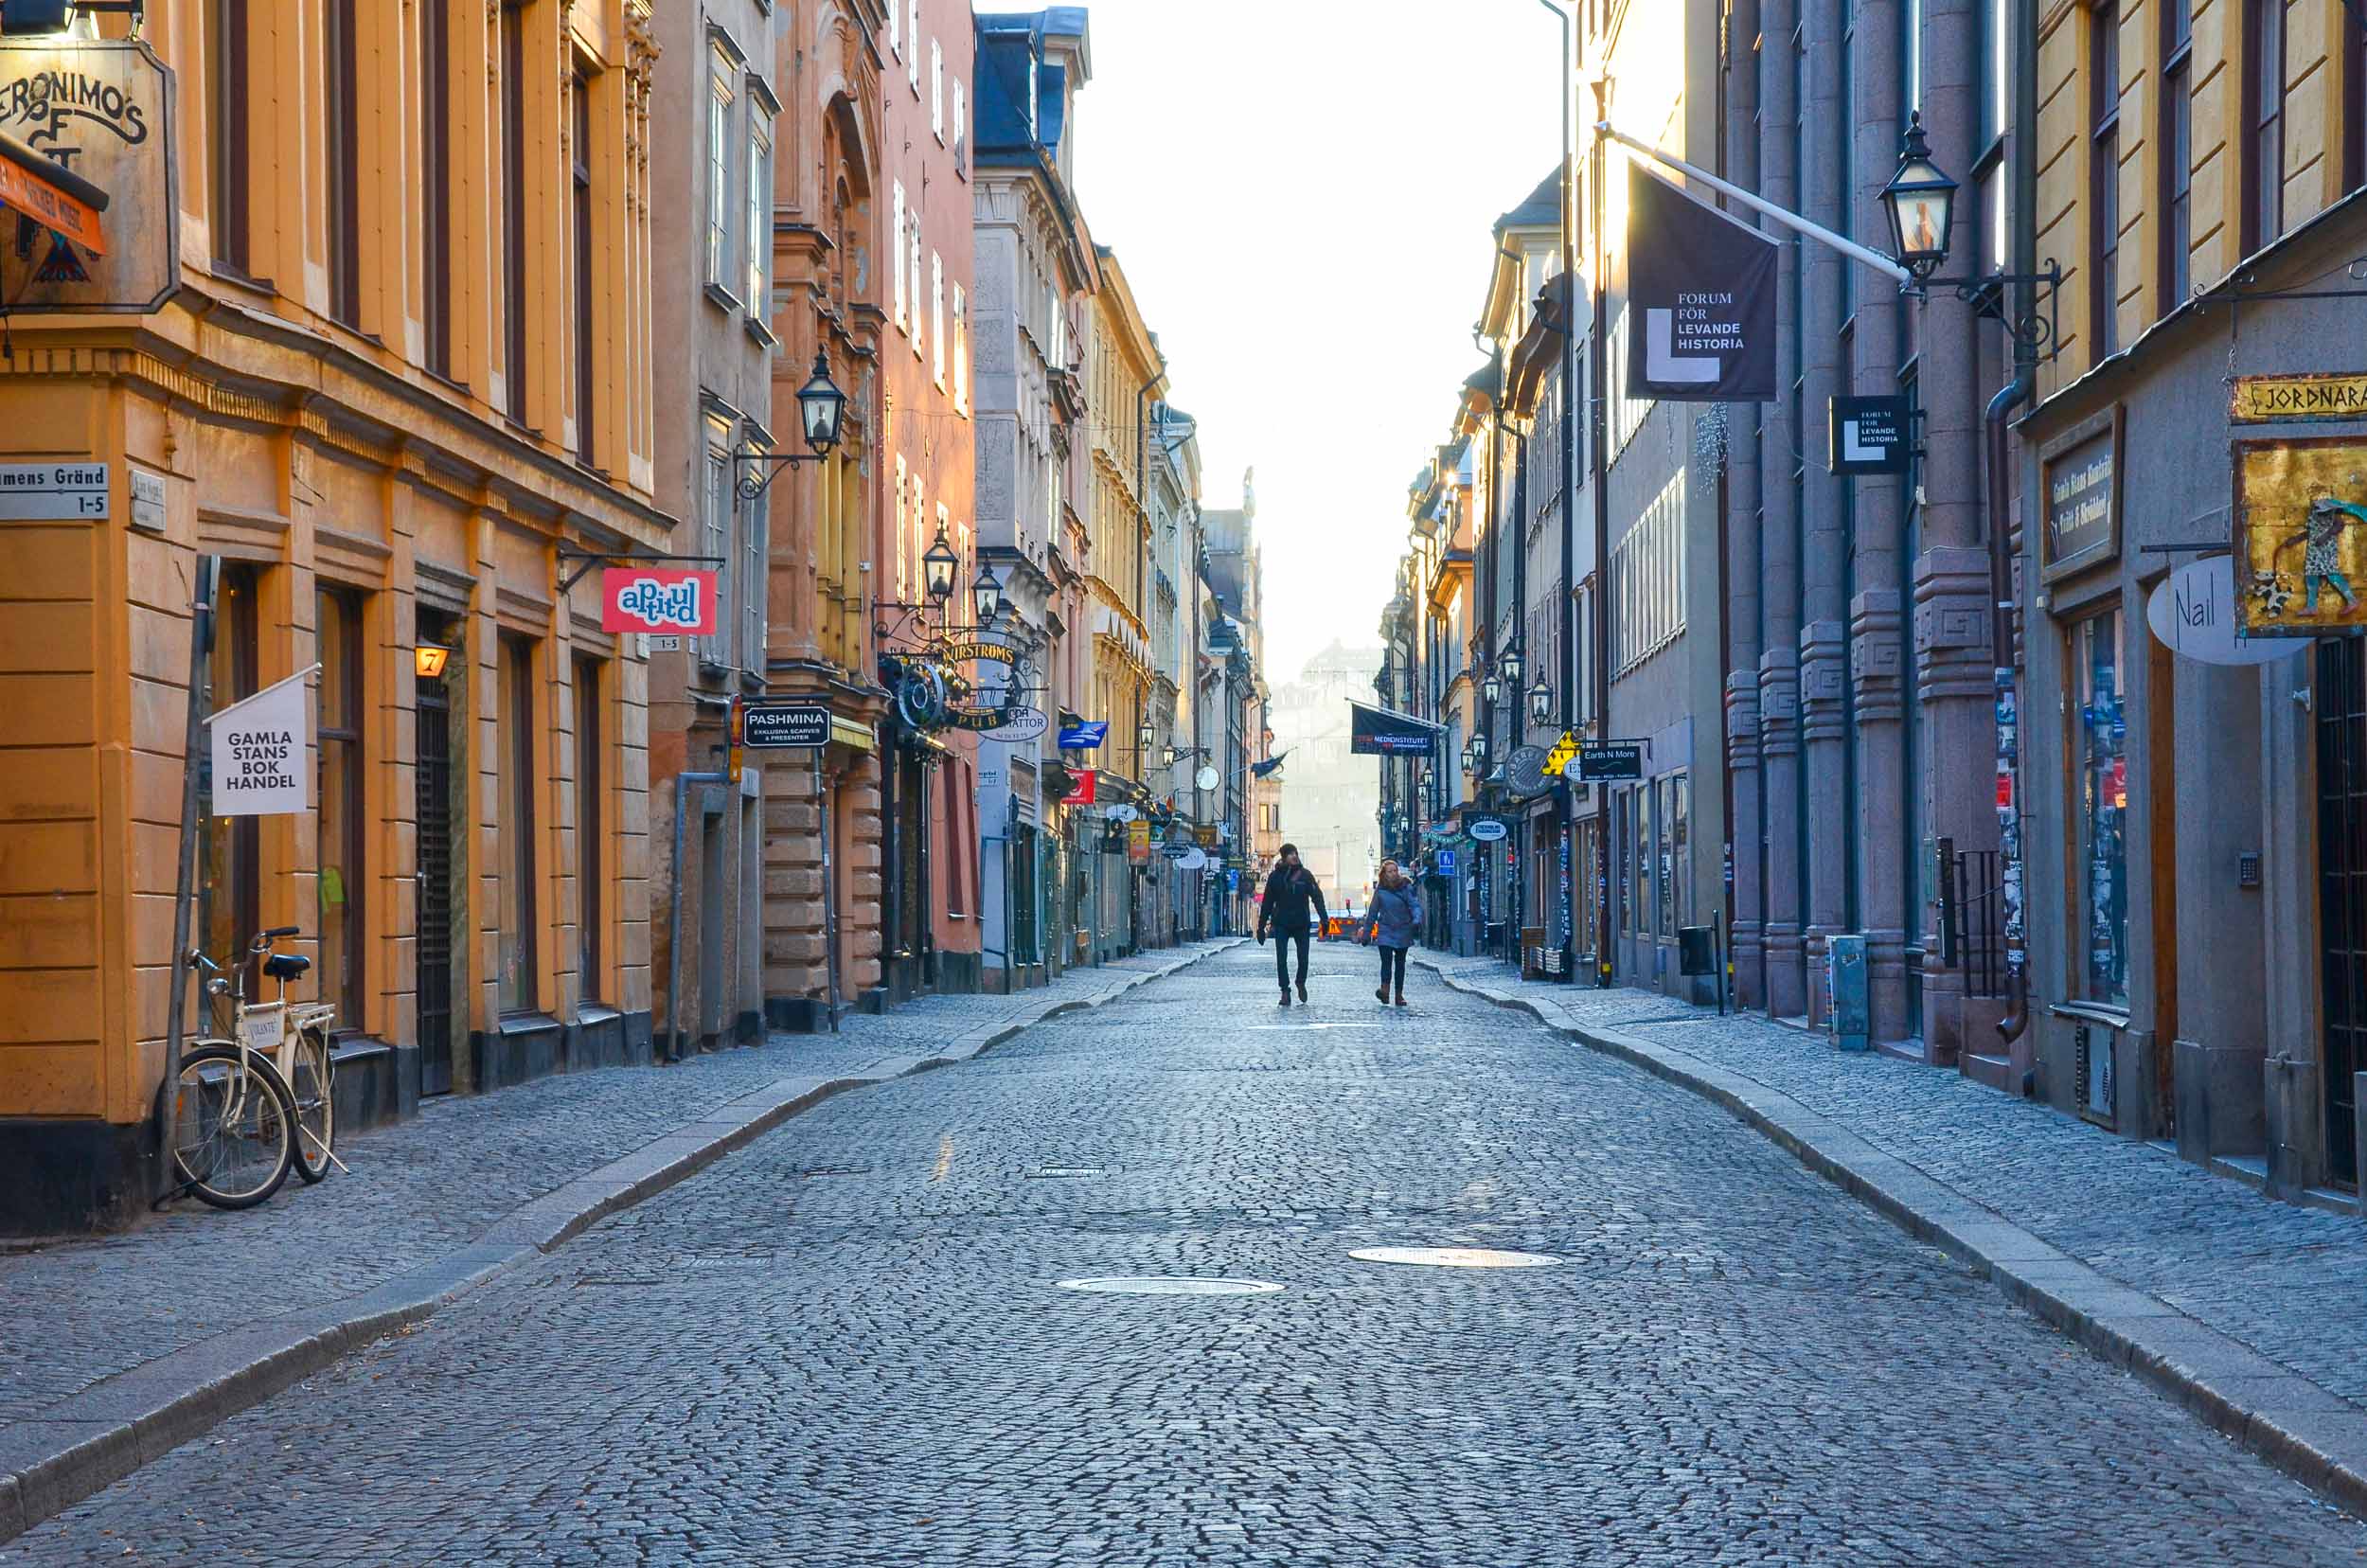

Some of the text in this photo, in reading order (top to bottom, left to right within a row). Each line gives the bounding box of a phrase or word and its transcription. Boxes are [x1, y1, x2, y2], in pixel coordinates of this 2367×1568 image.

[1678, 293, 1732, 304] FORUM
[1678, 307, 1707, 319] FÖR
[1678, 323, 1741, 334] LEVANDE
[1678, 338, 1744, 349] HISTORIA
[0, 467, 104, 485] mens Gränd
[79, 496, 104, 512] 1-5
[622, 582, 696, 622] aptitud
[423, 653, 436, 671] 7
[749, 714, 825, 725] PASHMINA
[958, 715, 998, 728] PUB
[228, 731, 293, 746] GAMLA
[233, 745, 288, 760] STANS
[1584, 751, 1605, 759] Earth
[241, 760, 279, 775] BOK
[226, 775, 296, 791] HANDEL
